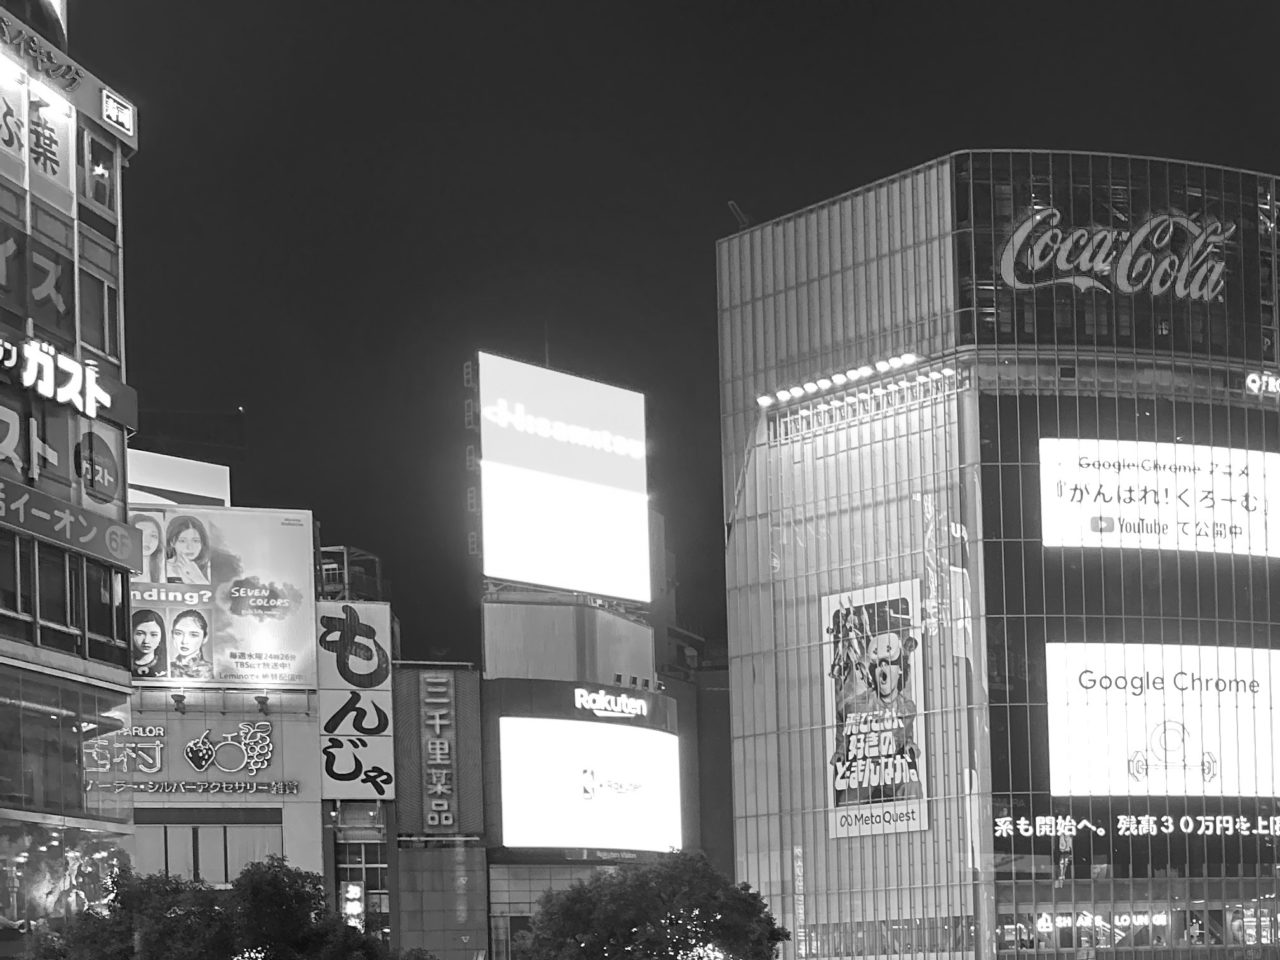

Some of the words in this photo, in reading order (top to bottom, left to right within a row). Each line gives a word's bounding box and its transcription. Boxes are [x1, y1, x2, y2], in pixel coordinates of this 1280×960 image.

[22, 340, 112, 418] ガスト
[1118, 517, 1169, 535] YouTube
[231, 587, 270, 597] SEVEN
[249, 598, 289, 607] COLORS
[1078, 670, 1164, 696] Google
[1173, 672, 1260, 694] Chrome
[319, 604, 393, 796] もんじゃ
[574, 688, 647, 717] Rakuten
[854, 814, 882, 824] Meta
[882, 809, 917, 824] Quest
